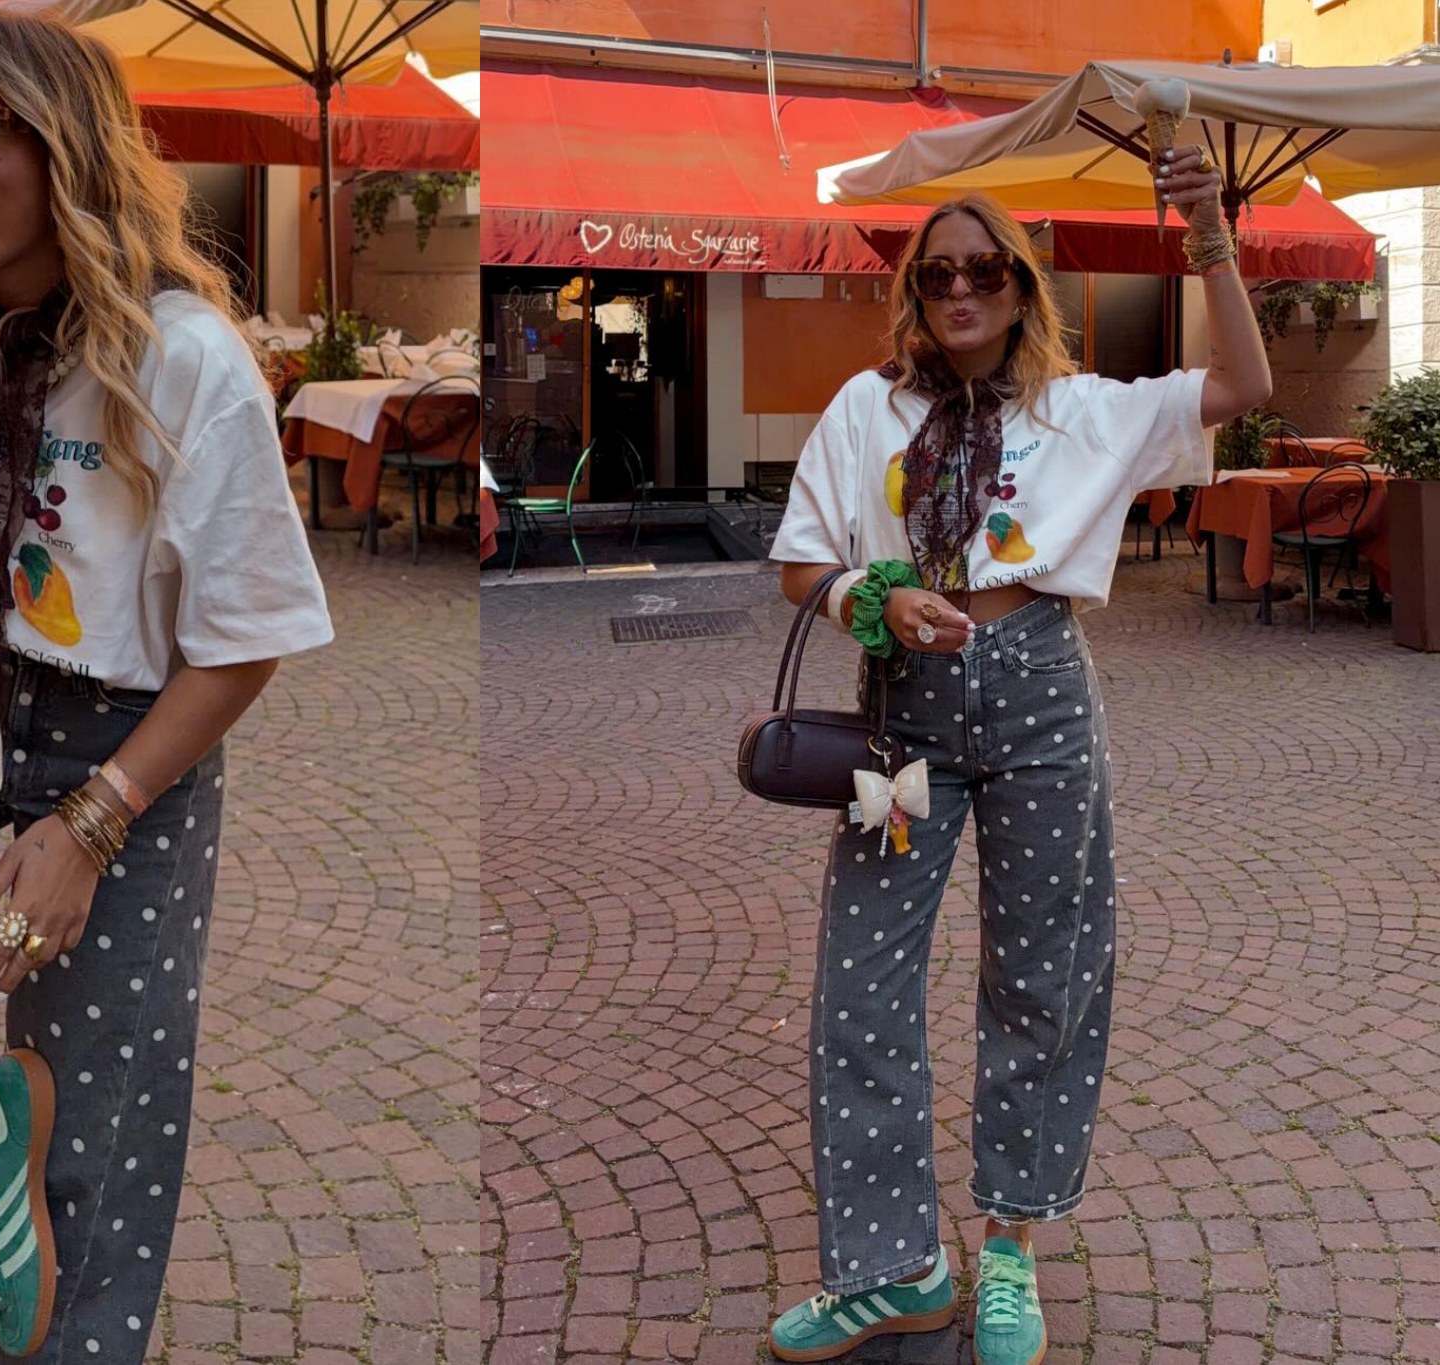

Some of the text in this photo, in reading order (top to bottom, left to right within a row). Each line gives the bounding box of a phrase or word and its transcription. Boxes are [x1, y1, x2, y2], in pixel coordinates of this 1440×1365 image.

[619, 223, 767, 264] Osteria Sgarzarie
[999, 501, 1029, 511] Cherry
[38, 531, 77, 553] Cherry
